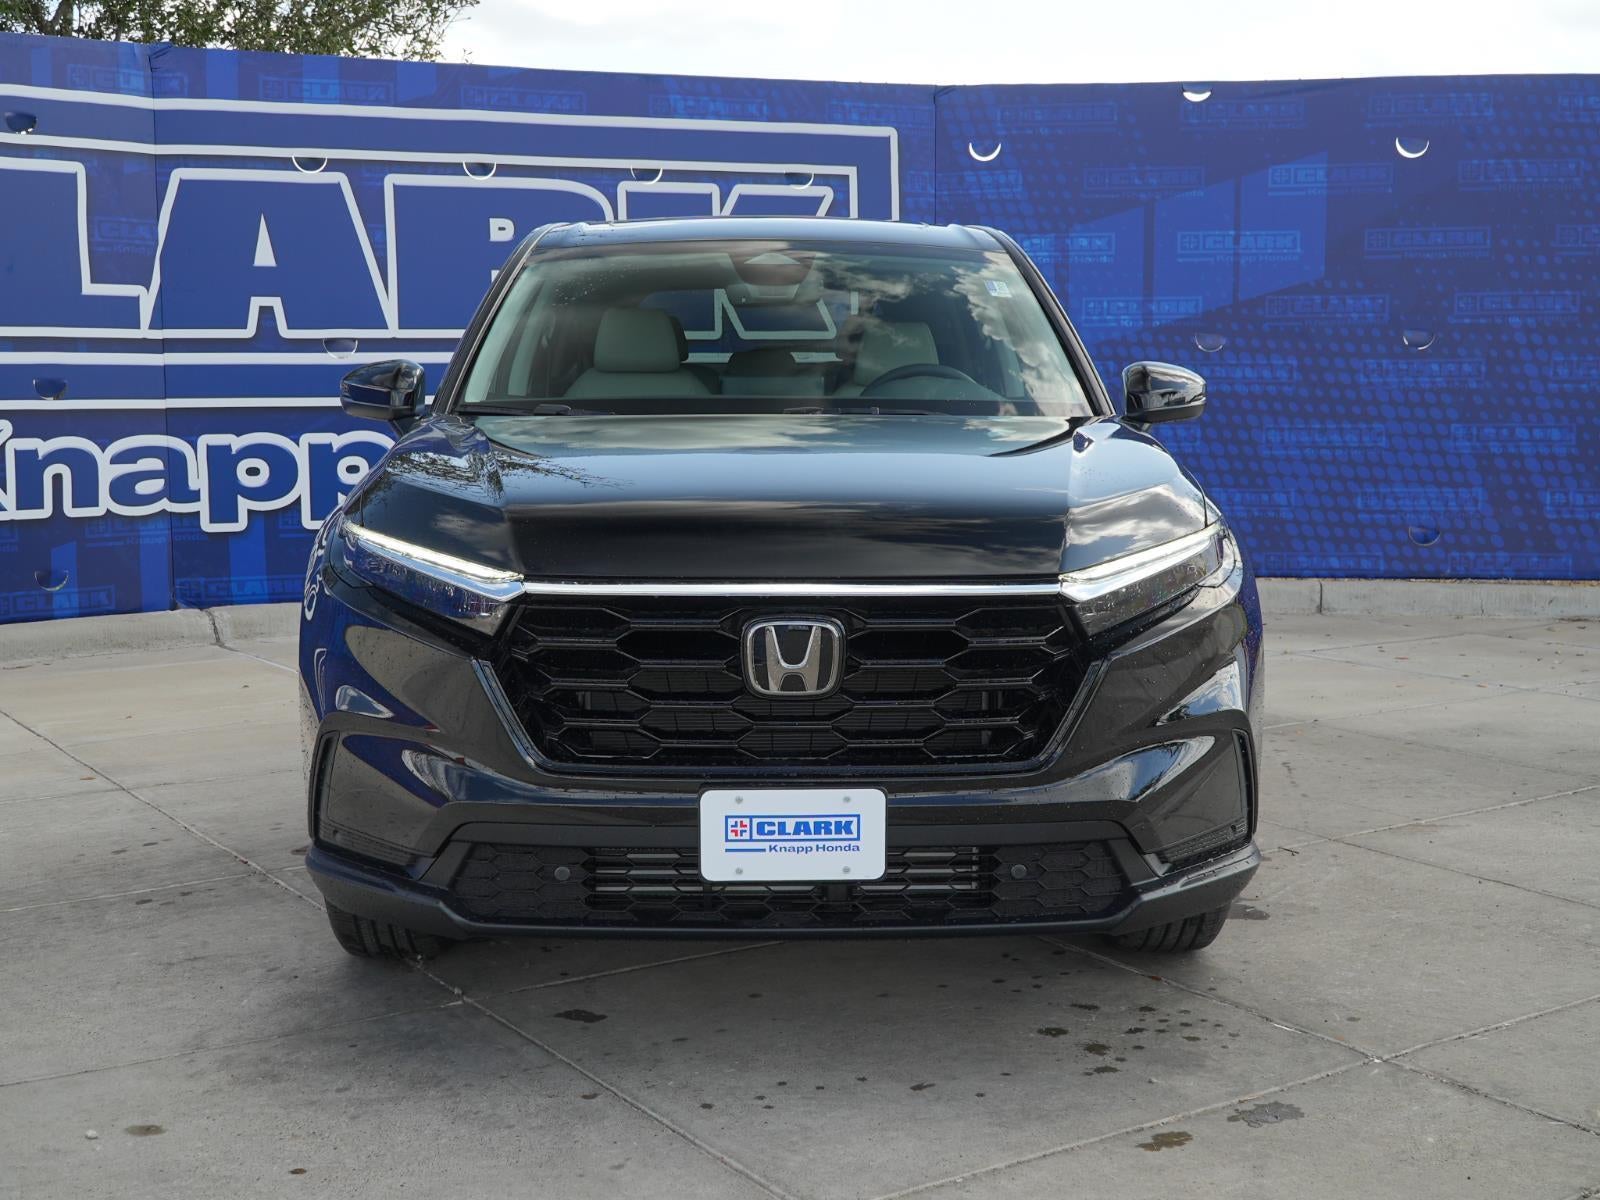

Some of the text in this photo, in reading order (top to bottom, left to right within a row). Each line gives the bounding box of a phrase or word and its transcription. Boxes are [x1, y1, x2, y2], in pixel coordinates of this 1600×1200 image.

[756, 820, 853, 836] CLARK
[768, 843, 860, 854] Knapp Honda
